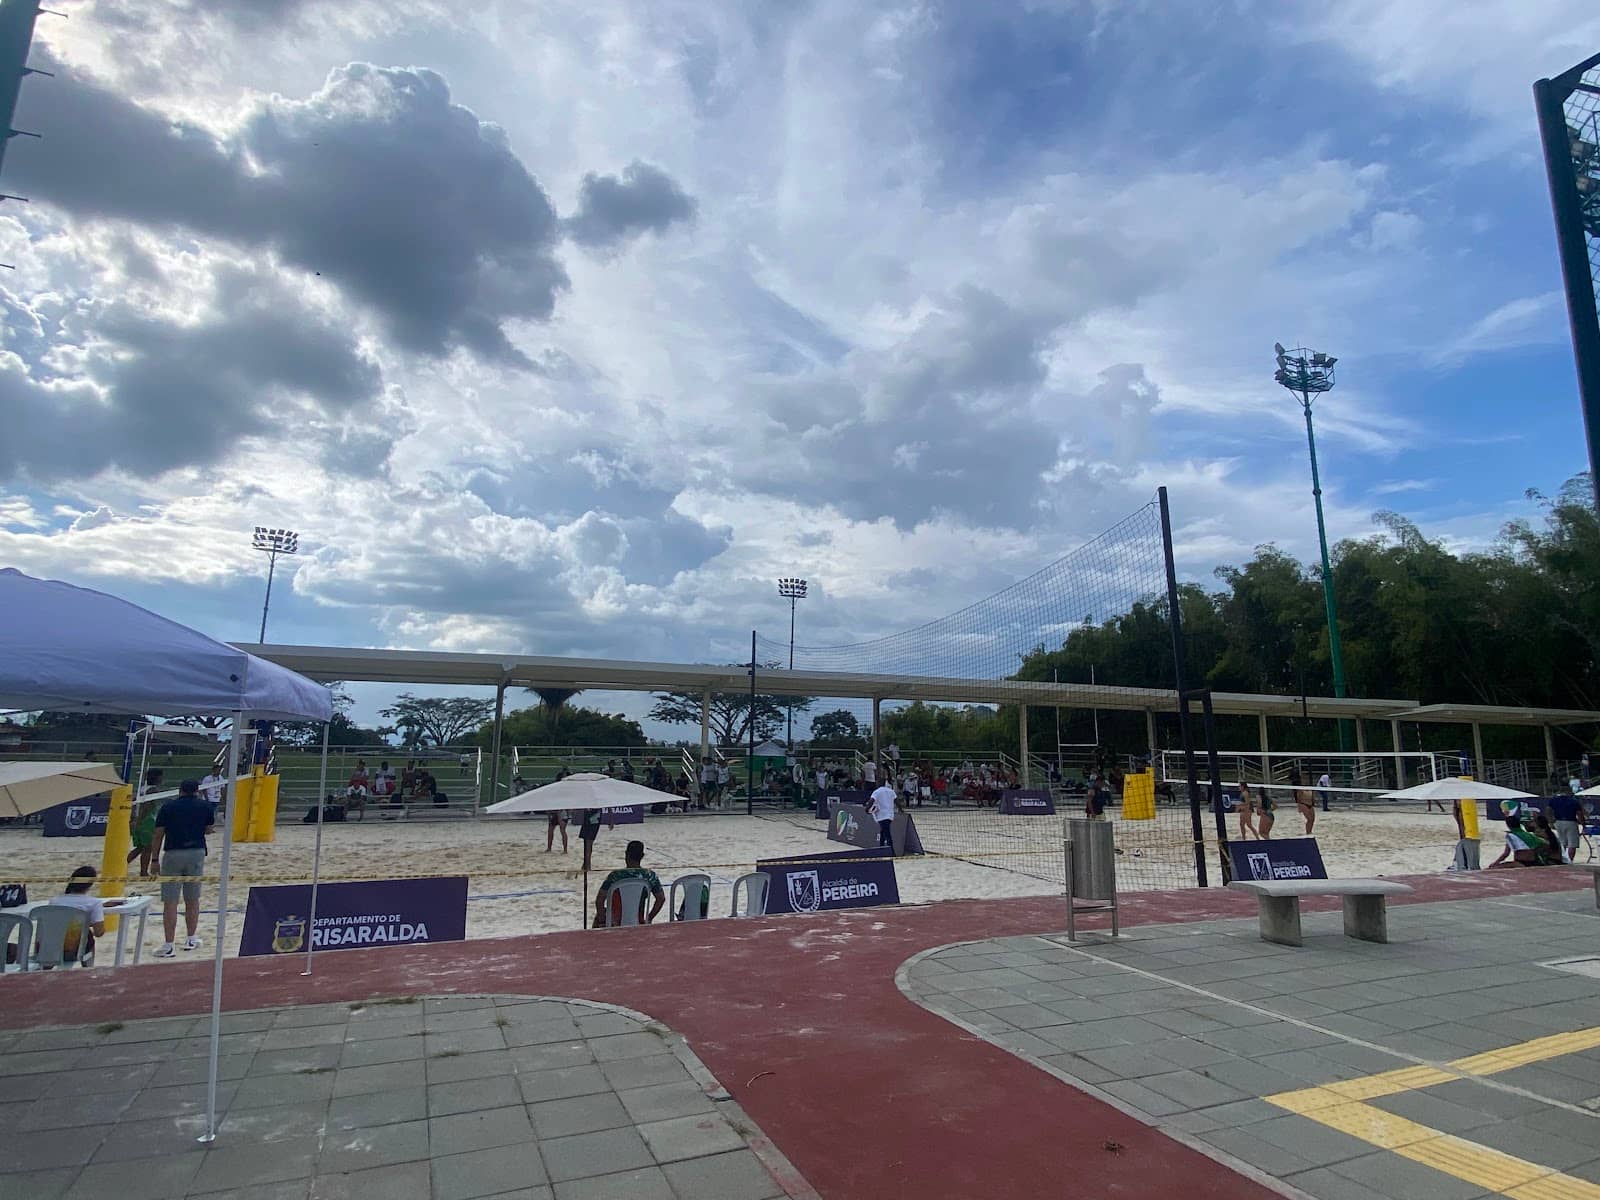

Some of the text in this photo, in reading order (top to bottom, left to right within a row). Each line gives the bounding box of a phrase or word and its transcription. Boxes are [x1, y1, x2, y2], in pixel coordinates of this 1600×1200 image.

[1273, 865, 1311, 878] PEREIRA
[822, 882, 878, 901] PEREIRA
[313, 914, 401, 927] DEPARTAMENTO DE
[311, 922, 428, 946] RISARALDA
